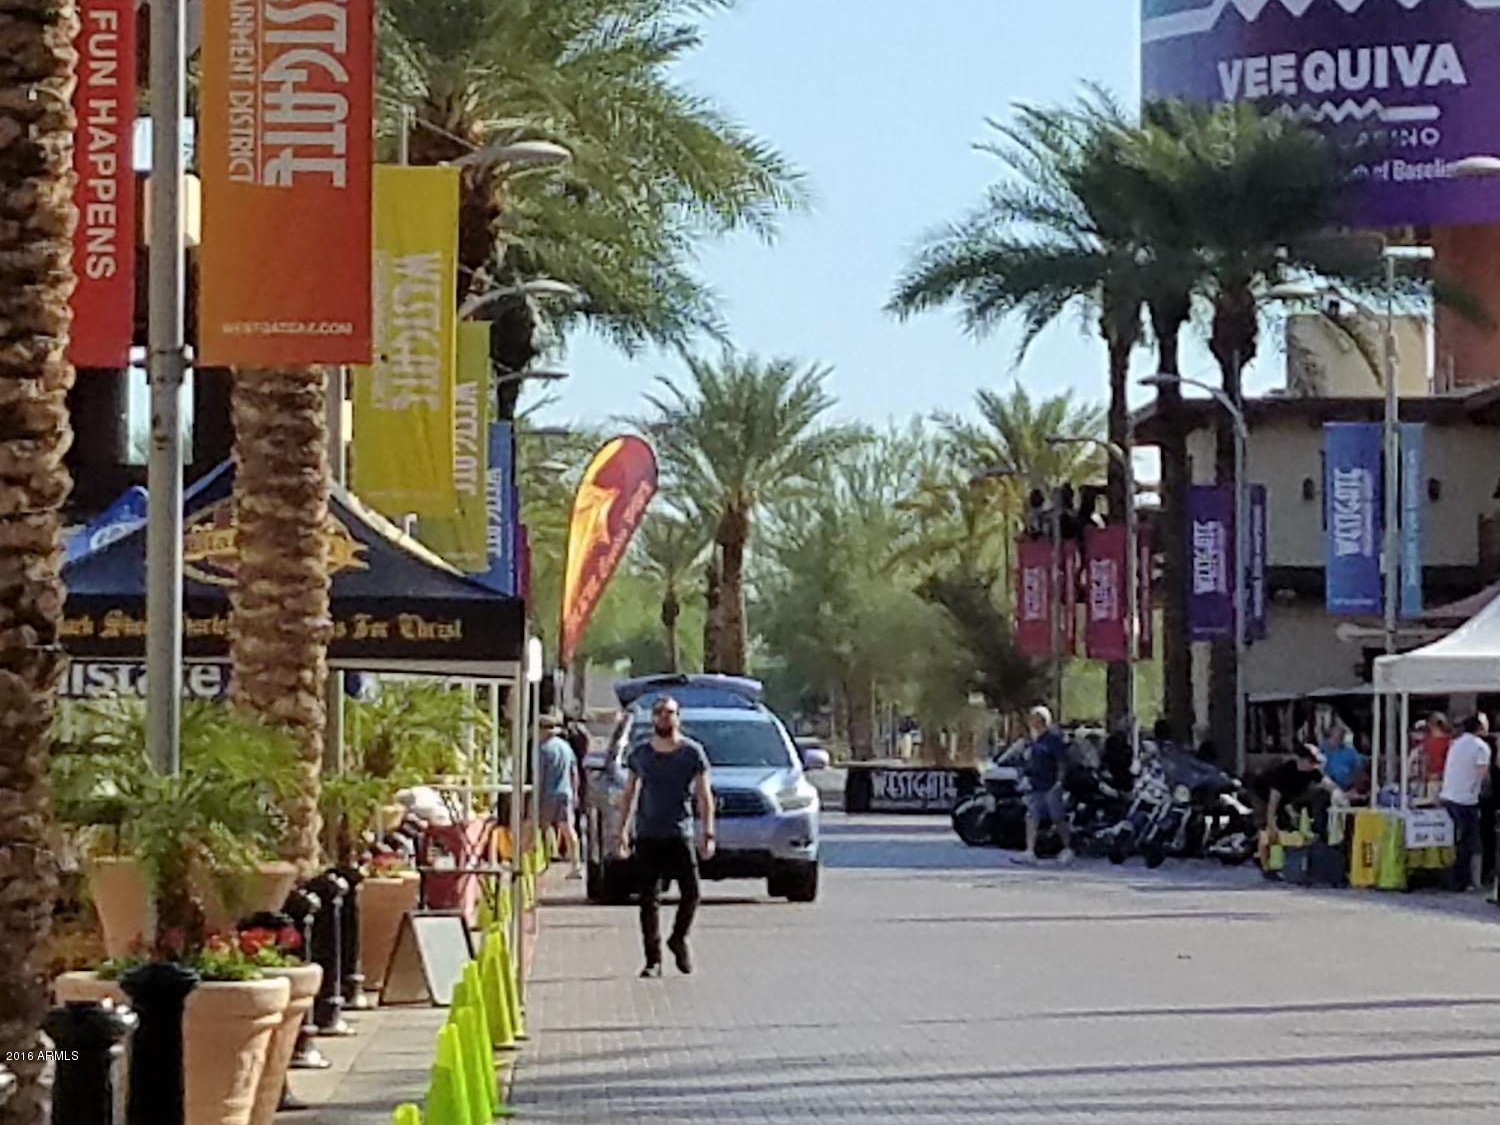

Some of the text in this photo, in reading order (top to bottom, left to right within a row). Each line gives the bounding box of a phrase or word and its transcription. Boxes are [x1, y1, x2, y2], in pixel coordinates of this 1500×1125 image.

[86, 7, 118, 85] FUN
[1217, 43, 1468, 102] VEE QUIVA
[227, 89, 254, 183] DISTRICT
[85, 98, 117, 280] HAPPENS
[392, 250, 442, 411] WESTGATE
